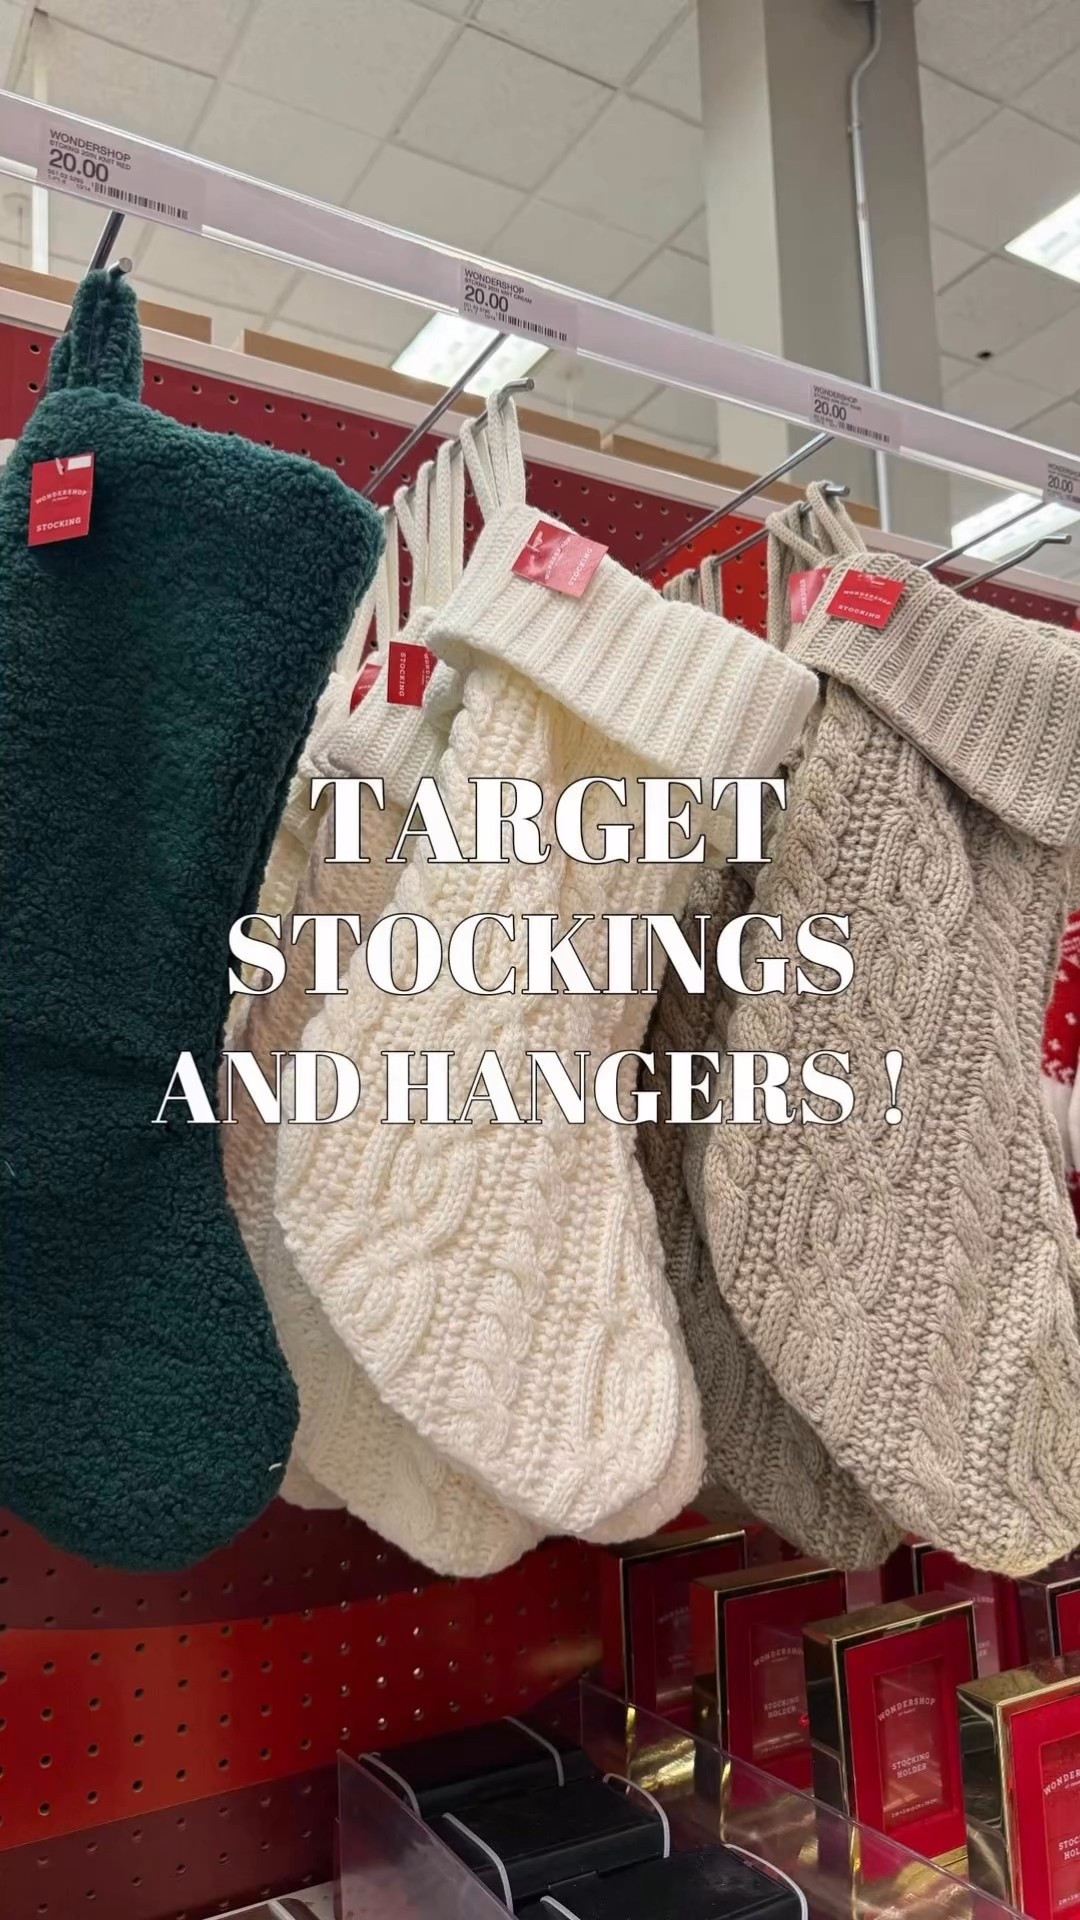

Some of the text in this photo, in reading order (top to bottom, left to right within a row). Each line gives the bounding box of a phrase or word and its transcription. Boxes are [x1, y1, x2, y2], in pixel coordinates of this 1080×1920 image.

[50, 129, 131, 162] WONDERSHOP
[49, 149, 109, 182] 20.00
[116, 162, 131, 170] RED
[465, 268, 524, 293] WONDERSHOP
[465, 285, 509, 312] 20.00
[813, 385, 858, 403] WONDERSHOP
[814, 399, 847, 421] 20.00
[1048, 475, 1073, 494] 20.00
[35, 489, 88, 504] WONDERSHOP
[36, 516, 81, 532] STOCKING
[568, 547, 593, 586] STOCKING
[843, 590, 892, 605] WONDERSHOP
[838, 604, 881, 619] STOCKING
[399, 652, 407, 697] STOCKING
[763, 1696, 800, 1711] STOCKING
[878, 1697, 936, 1721] WONDERSHOP
[891, 1752, 930, 1770] STOCKING
[897, 1763, 927, 1779] HOLDER
[1058, 1835, 1080, 1850] STOC
